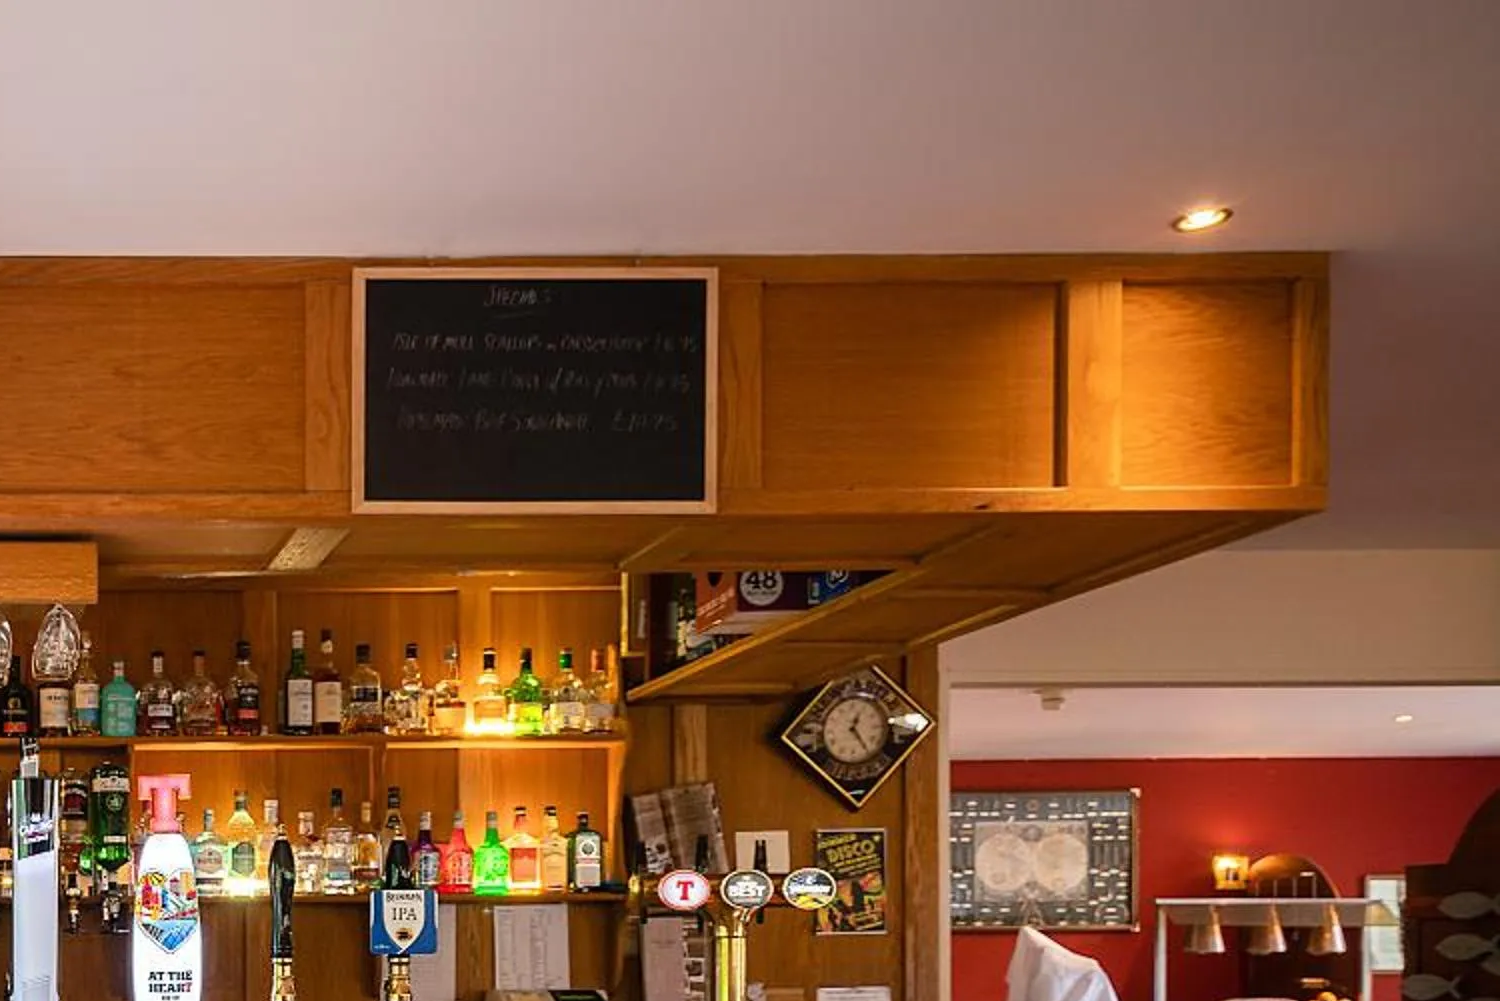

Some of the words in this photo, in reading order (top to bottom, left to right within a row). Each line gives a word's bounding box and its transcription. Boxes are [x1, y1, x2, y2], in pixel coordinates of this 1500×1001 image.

[676, 880, 695, 901] T
[391, 907, 417, 921] IPA
[148, 971, 165, 981] AT
[168, 970, 193, 981] THE
[149, 983, 193, 993] HEART
